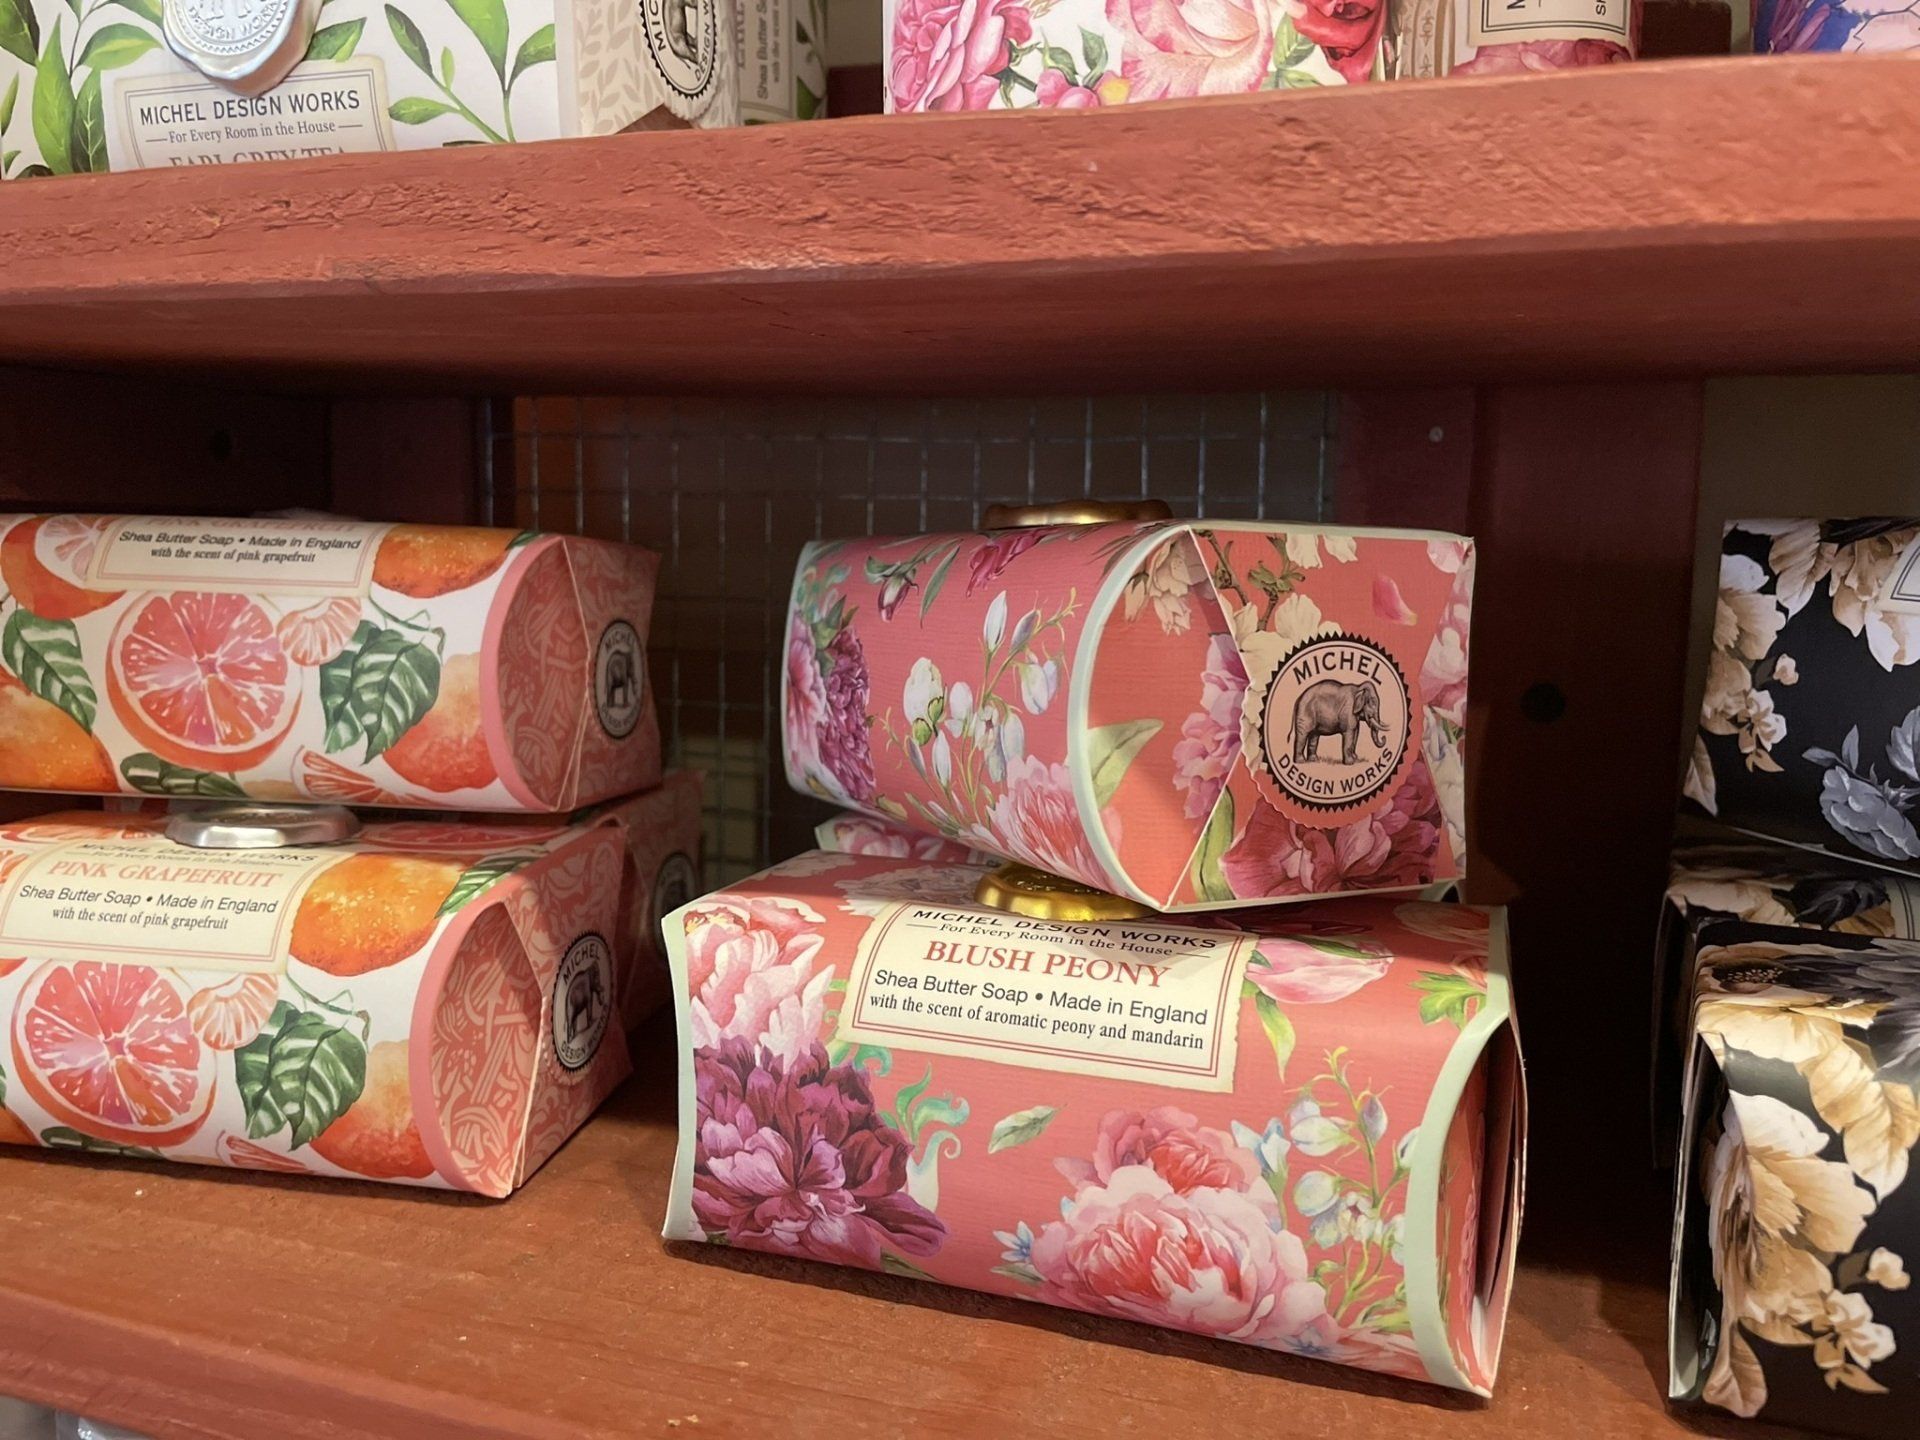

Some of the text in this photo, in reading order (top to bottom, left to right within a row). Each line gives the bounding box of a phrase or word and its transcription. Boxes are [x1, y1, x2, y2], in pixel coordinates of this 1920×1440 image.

[694, 23, 711, 82] DESIGN
[139, 90, 360, 126] MICHEL DESIGN WORKS
[169, 120, 336, 143] For Every Room in the House
[119, 531, 362, 550] Shea Butter Soap Made in England
[151, 547, 316, 564] with the scent of pink grapefruit
[1293, 651, 1383, 685] MICHEL
[1278, 747, 1393, 795] DESIGN WORKS
[47, 860, 284, 888] PINK GRAPEFRUIT
[20, 885, 279, 914] Shea Butter Soap Made in England
[52, 907, 229, 930] with the scent of pink grapefruit
[913, 910, 1217, 948] MICHEL DESIGN WORKS
[939, 923, 1173, 956] For Every Room in the House
[563, 943, 600, 985] MICHEL
[922, 940, 1172, 988] BLUSH PEONY
[875, 969, 1208, 1025] Shea Butter Soap Made in England
[870, 994, 1204, 1049] with the scent of aromatic peony and mandarin
